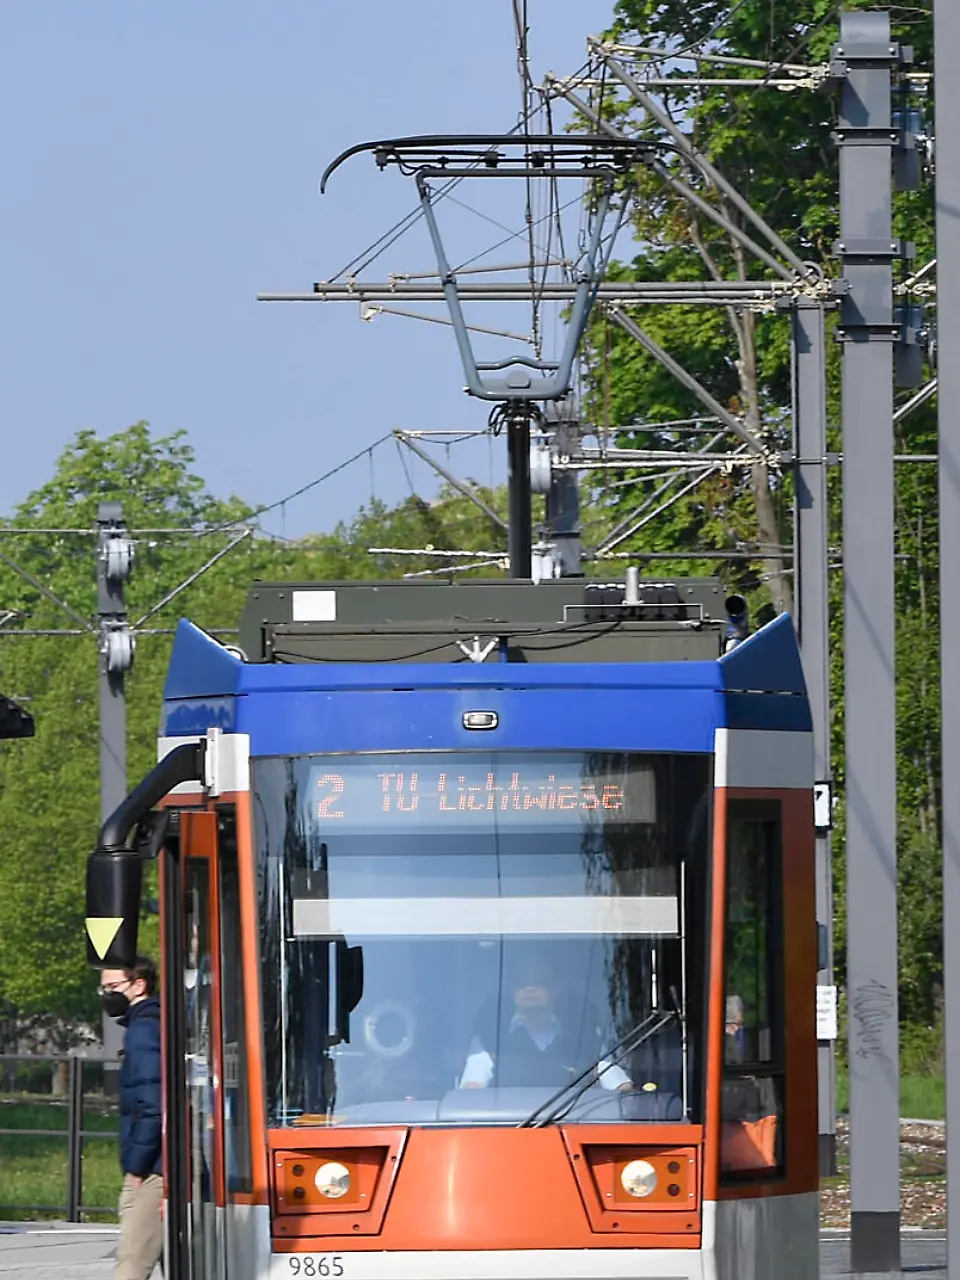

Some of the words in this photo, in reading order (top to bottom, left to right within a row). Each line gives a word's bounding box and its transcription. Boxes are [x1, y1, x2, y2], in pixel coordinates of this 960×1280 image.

[317, 774, 345, 819] 2
[438, 772, 624, 812] Lichtwiese
[289, 1257, 344, 1276] 9865
